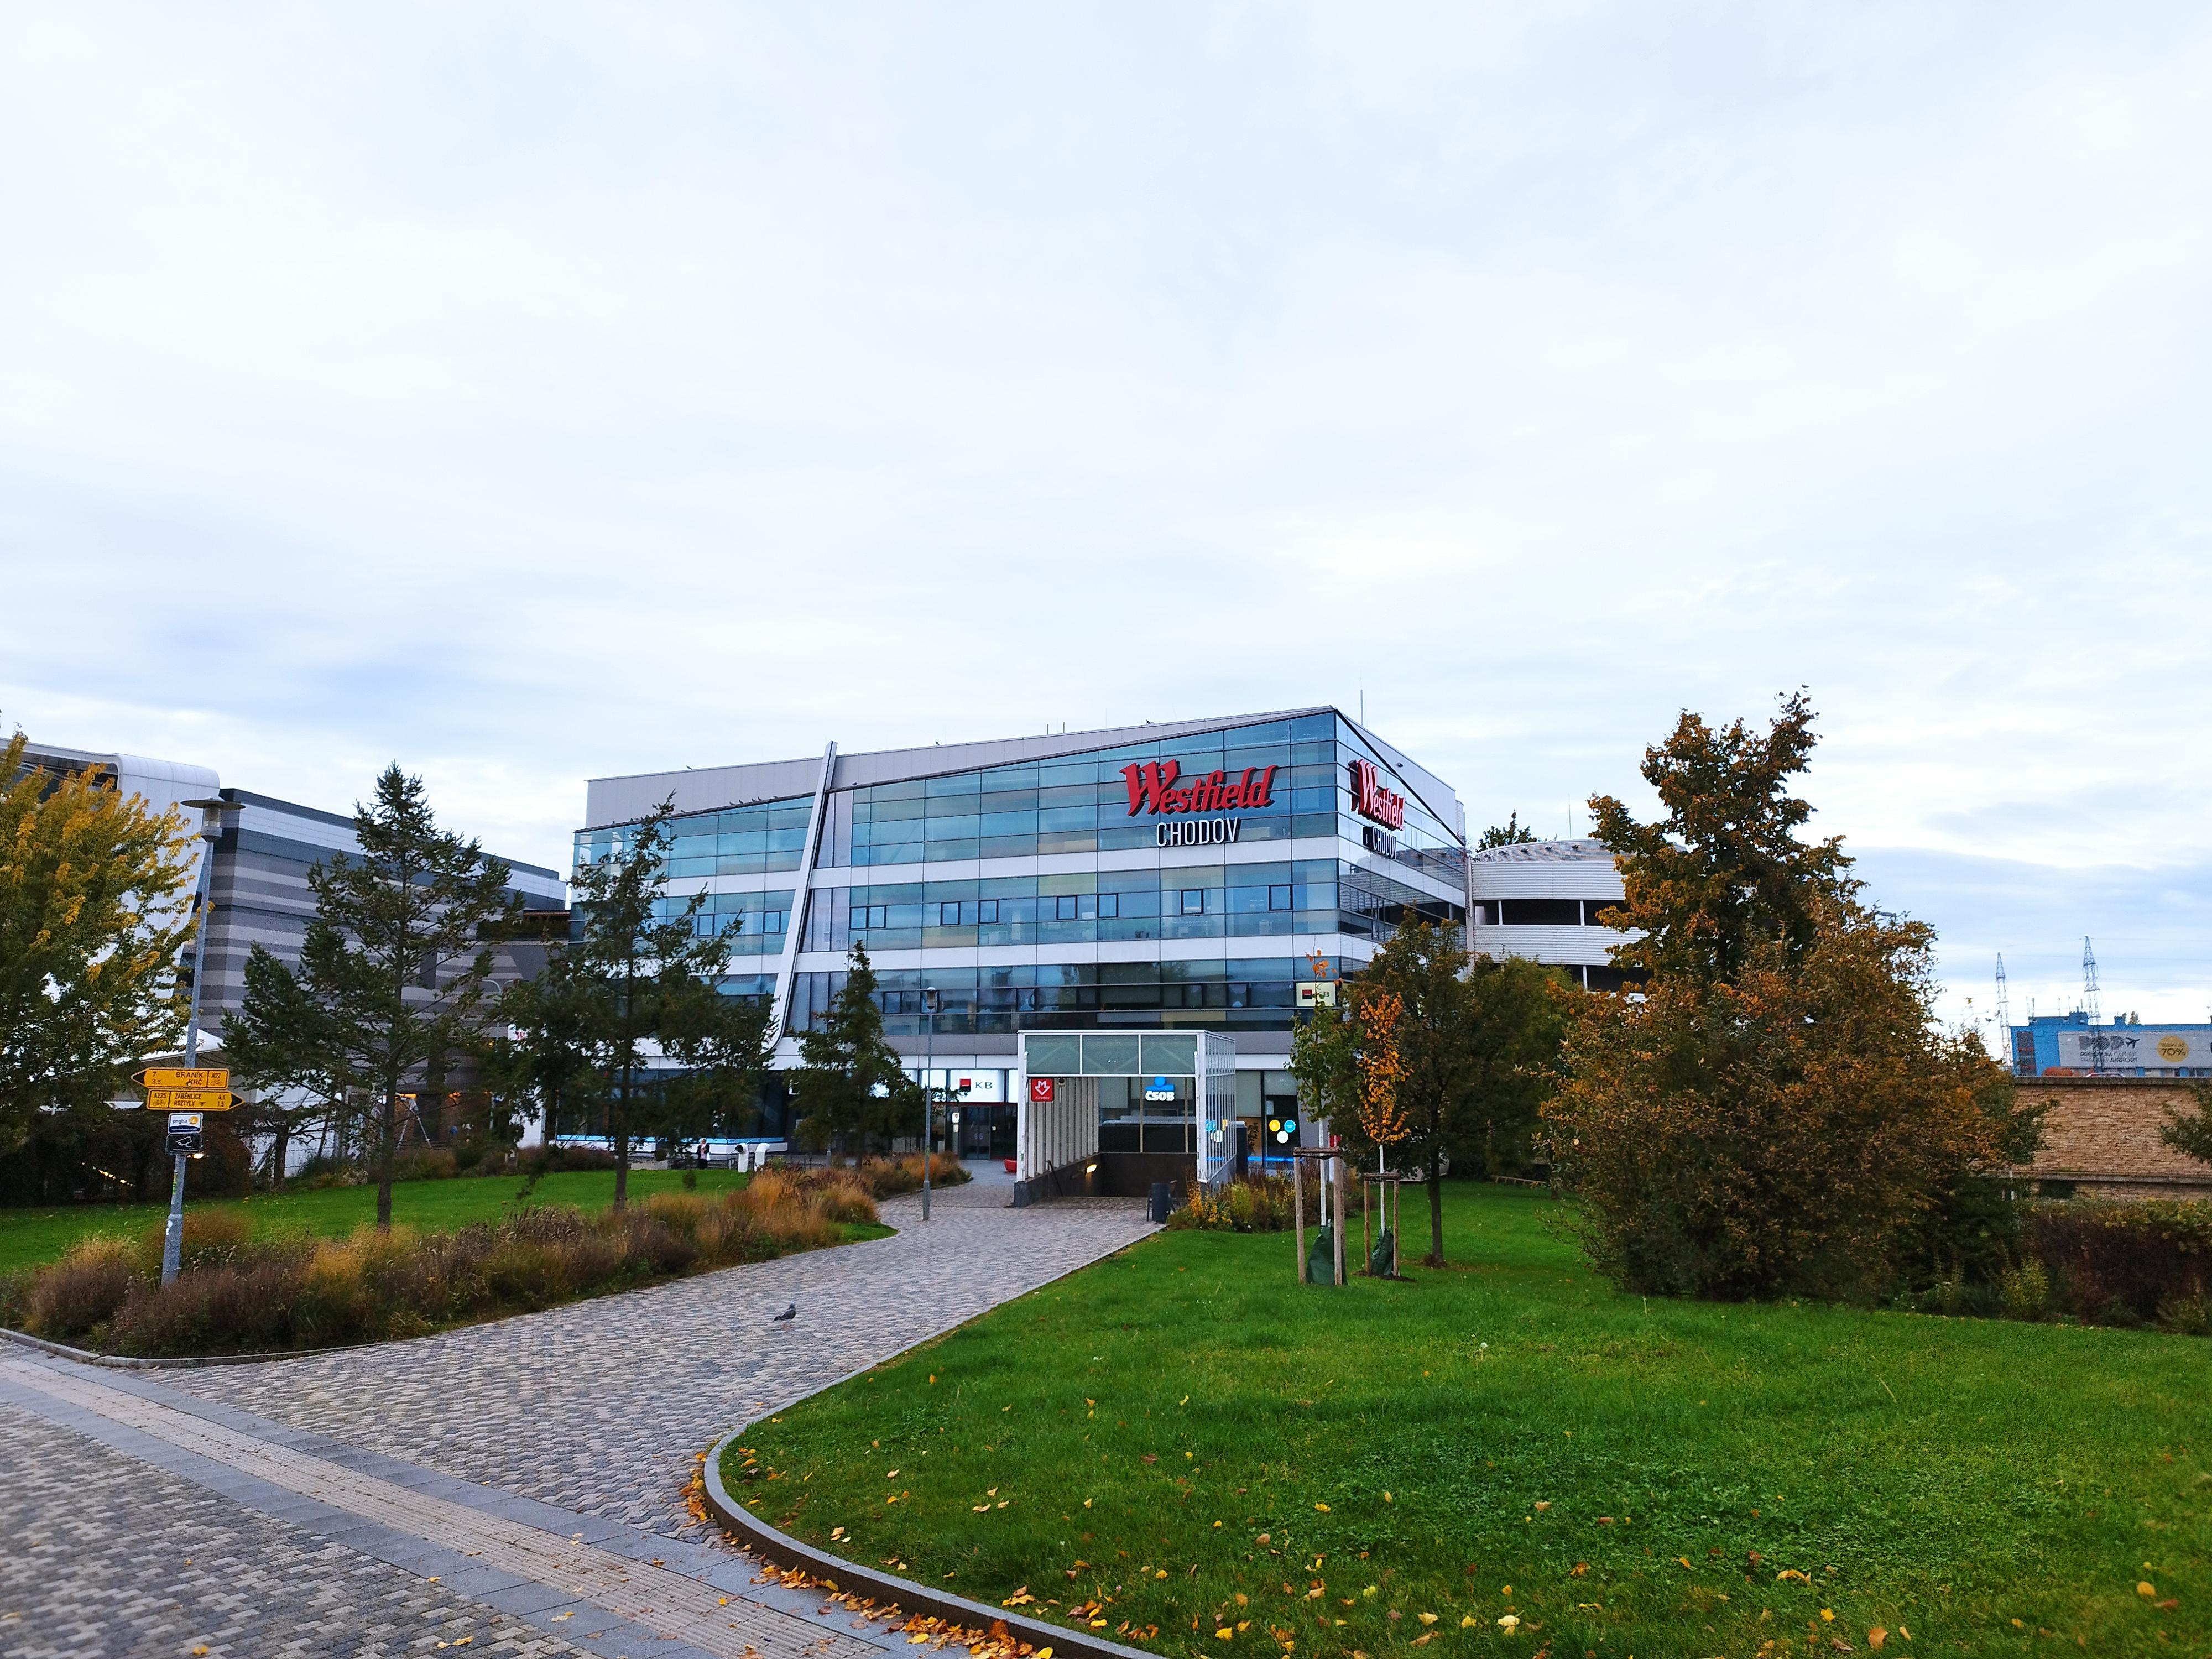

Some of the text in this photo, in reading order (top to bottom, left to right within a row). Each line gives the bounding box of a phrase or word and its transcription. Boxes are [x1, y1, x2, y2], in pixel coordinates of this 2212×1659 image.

[1119, 759, 1279, 816] Westfield
[1358, 759, 1406, 830] Westfield
[1156, 817, 1239, 847] CHODOV
[1373, 827, 1397, 859] CHODOV
[1145, 1090, 1175, 1101] ČSOB
